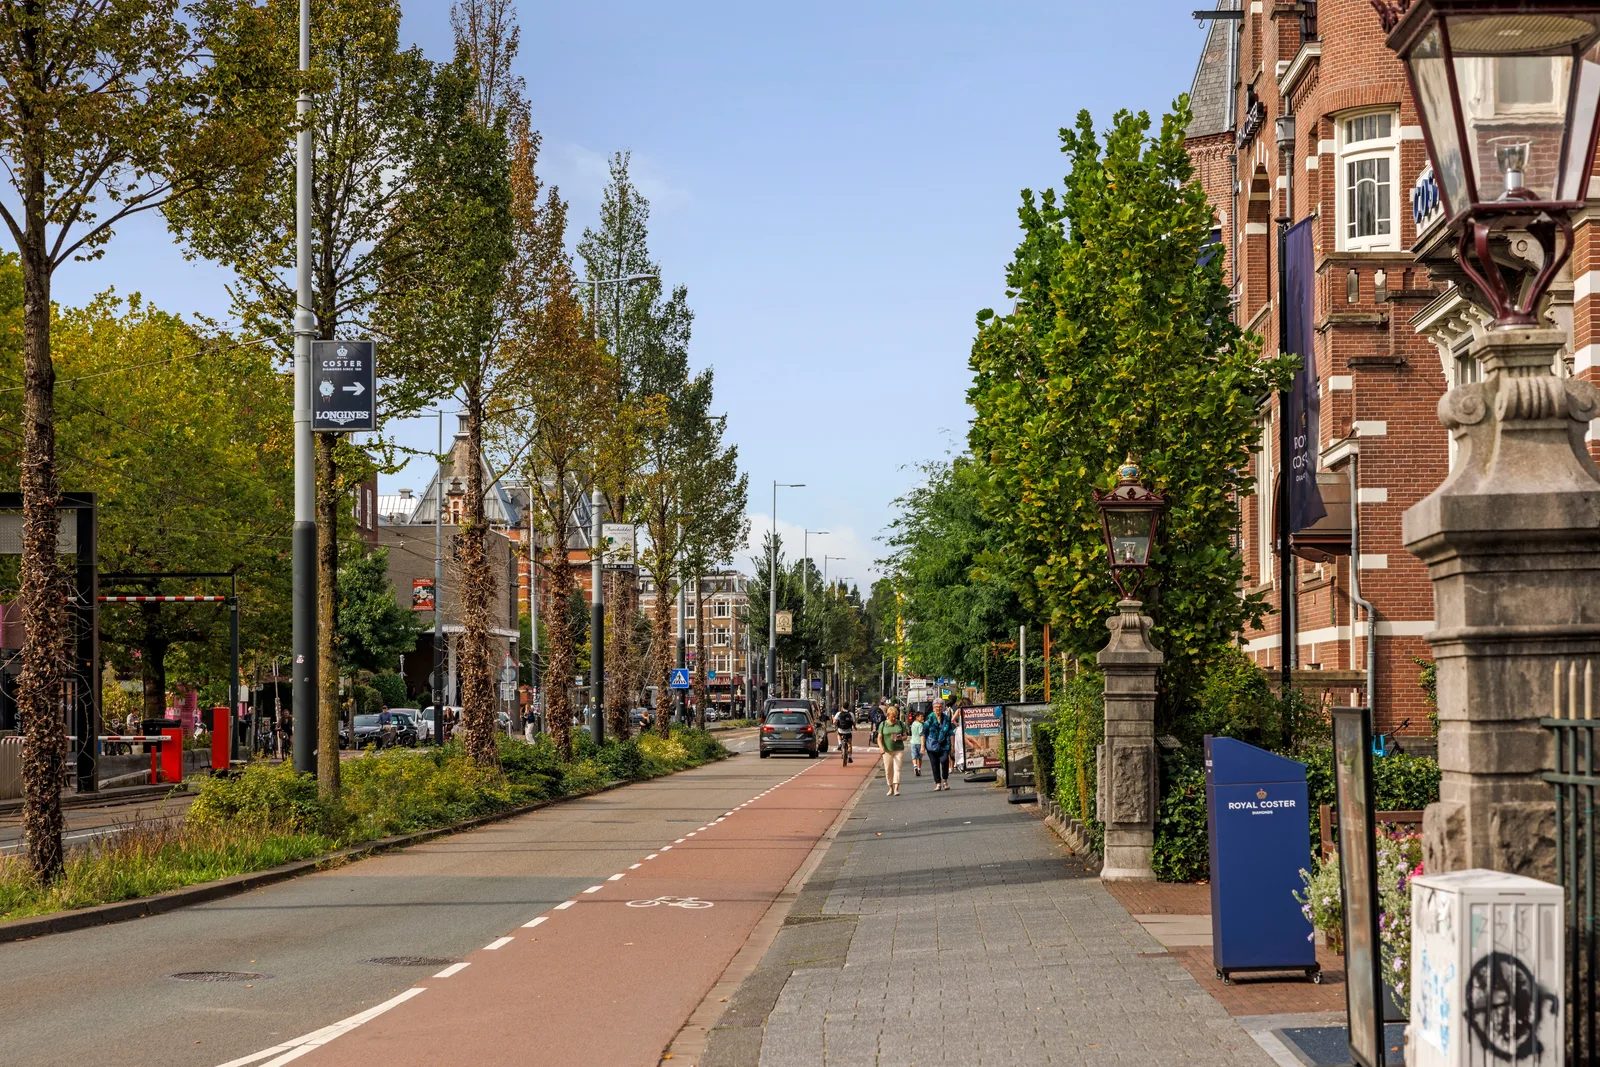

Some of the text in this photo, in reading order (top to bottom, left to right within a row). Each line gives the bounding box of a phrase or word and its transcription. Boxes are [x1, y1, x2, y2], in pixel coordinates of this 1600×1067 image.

[316, 411, 369, 419] LONGINES
[1228, 799, 1296, 810] ROYAL COSTER
